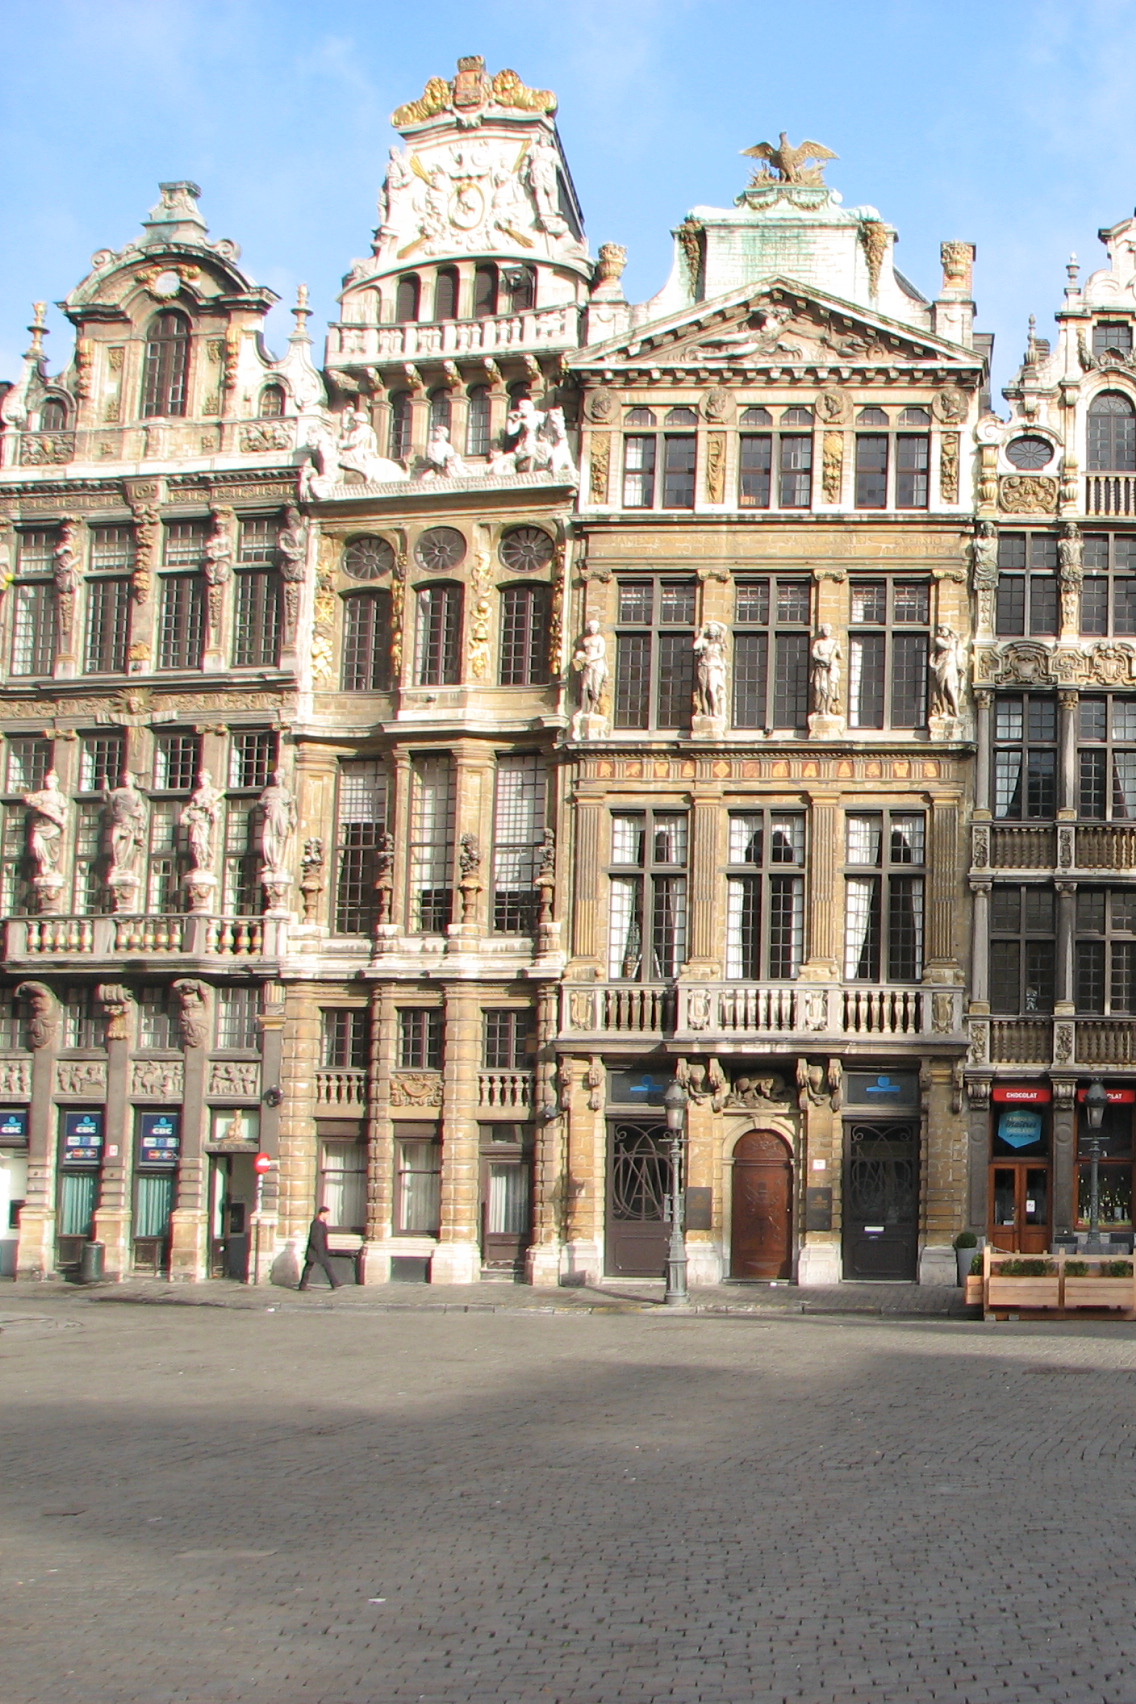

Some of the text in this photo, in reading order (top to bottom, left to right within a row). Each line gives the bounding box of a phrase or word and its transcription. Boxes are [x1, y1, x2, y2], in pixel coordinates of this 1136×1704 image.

[1, 1126, 21, 1134] CBC
[75, 1126, 96, 1134] CBC
[152, 1127, 173, 1135] CBC
